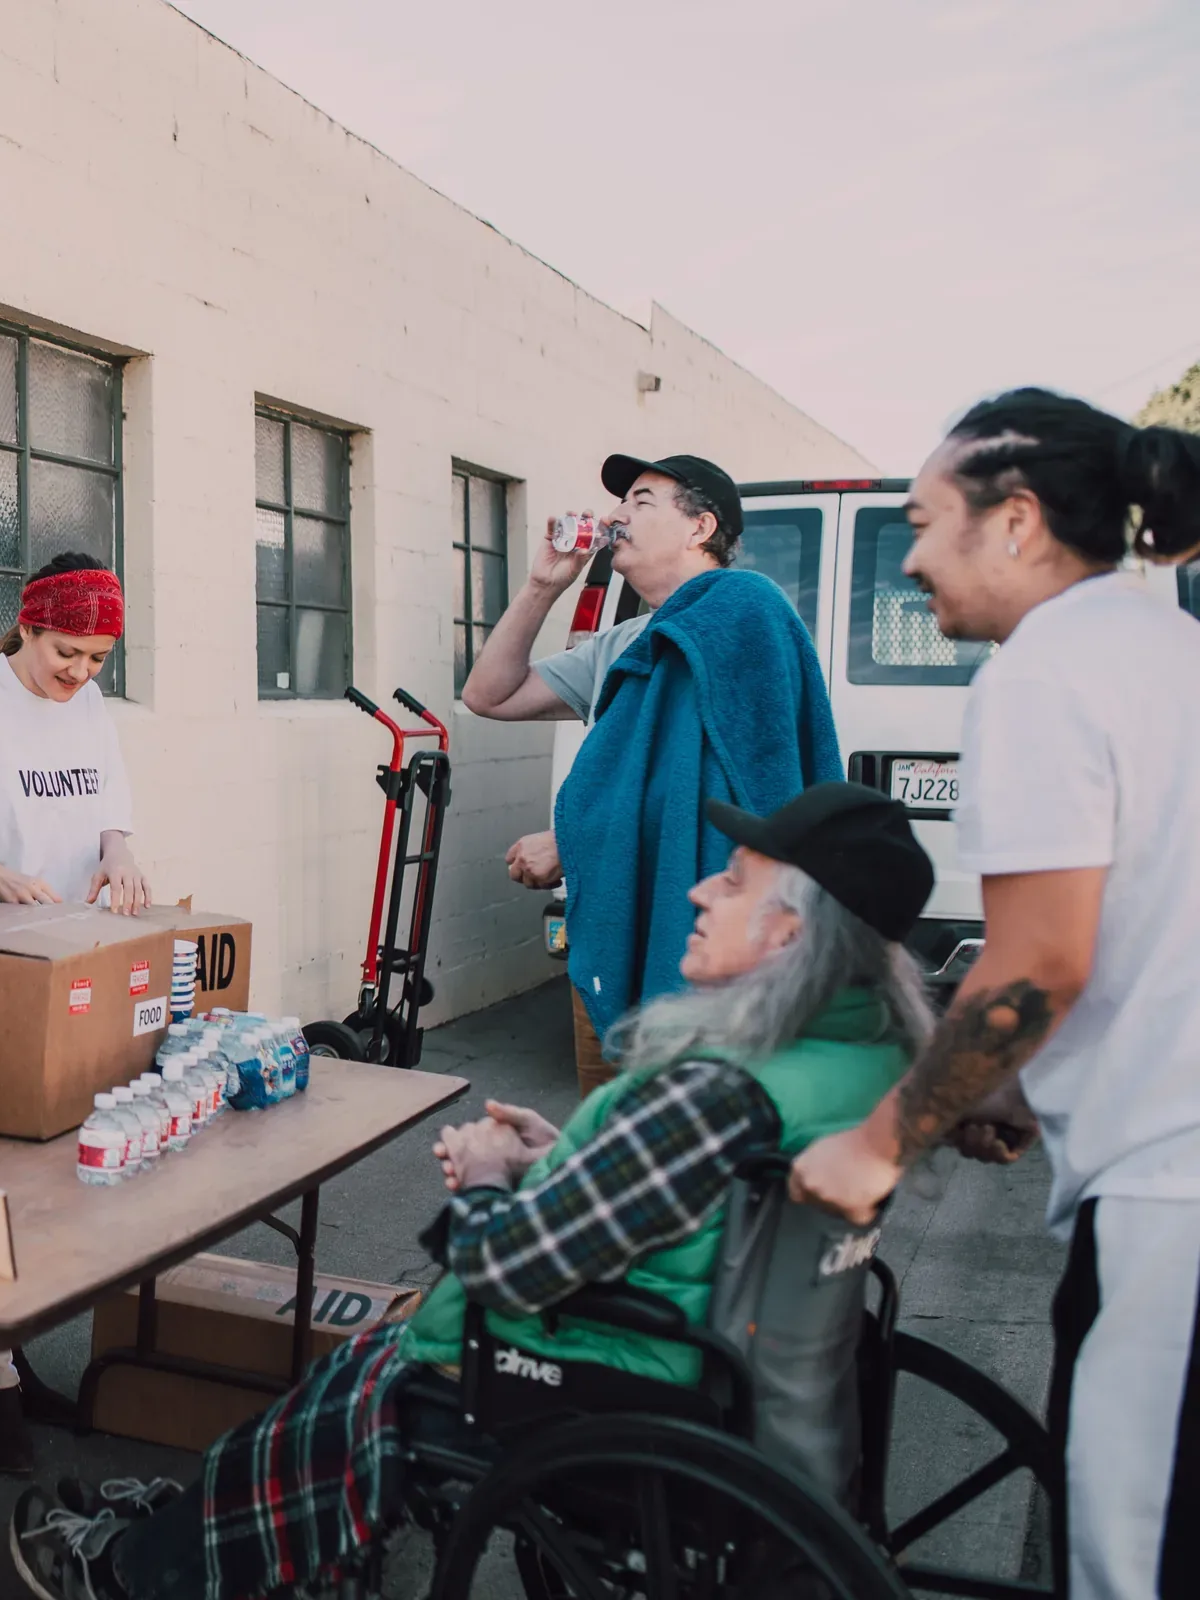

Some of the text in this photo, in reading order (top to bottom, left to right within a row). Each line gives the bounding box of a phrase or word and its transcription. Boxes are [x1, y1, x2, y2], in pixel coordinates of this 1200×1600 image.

[898, 764, 911, 772] JAN
[194, 932, 236, 992] AID
[139, 1006, 162, 1027] FOOD
[494, 1347, 563, 1387] drive
